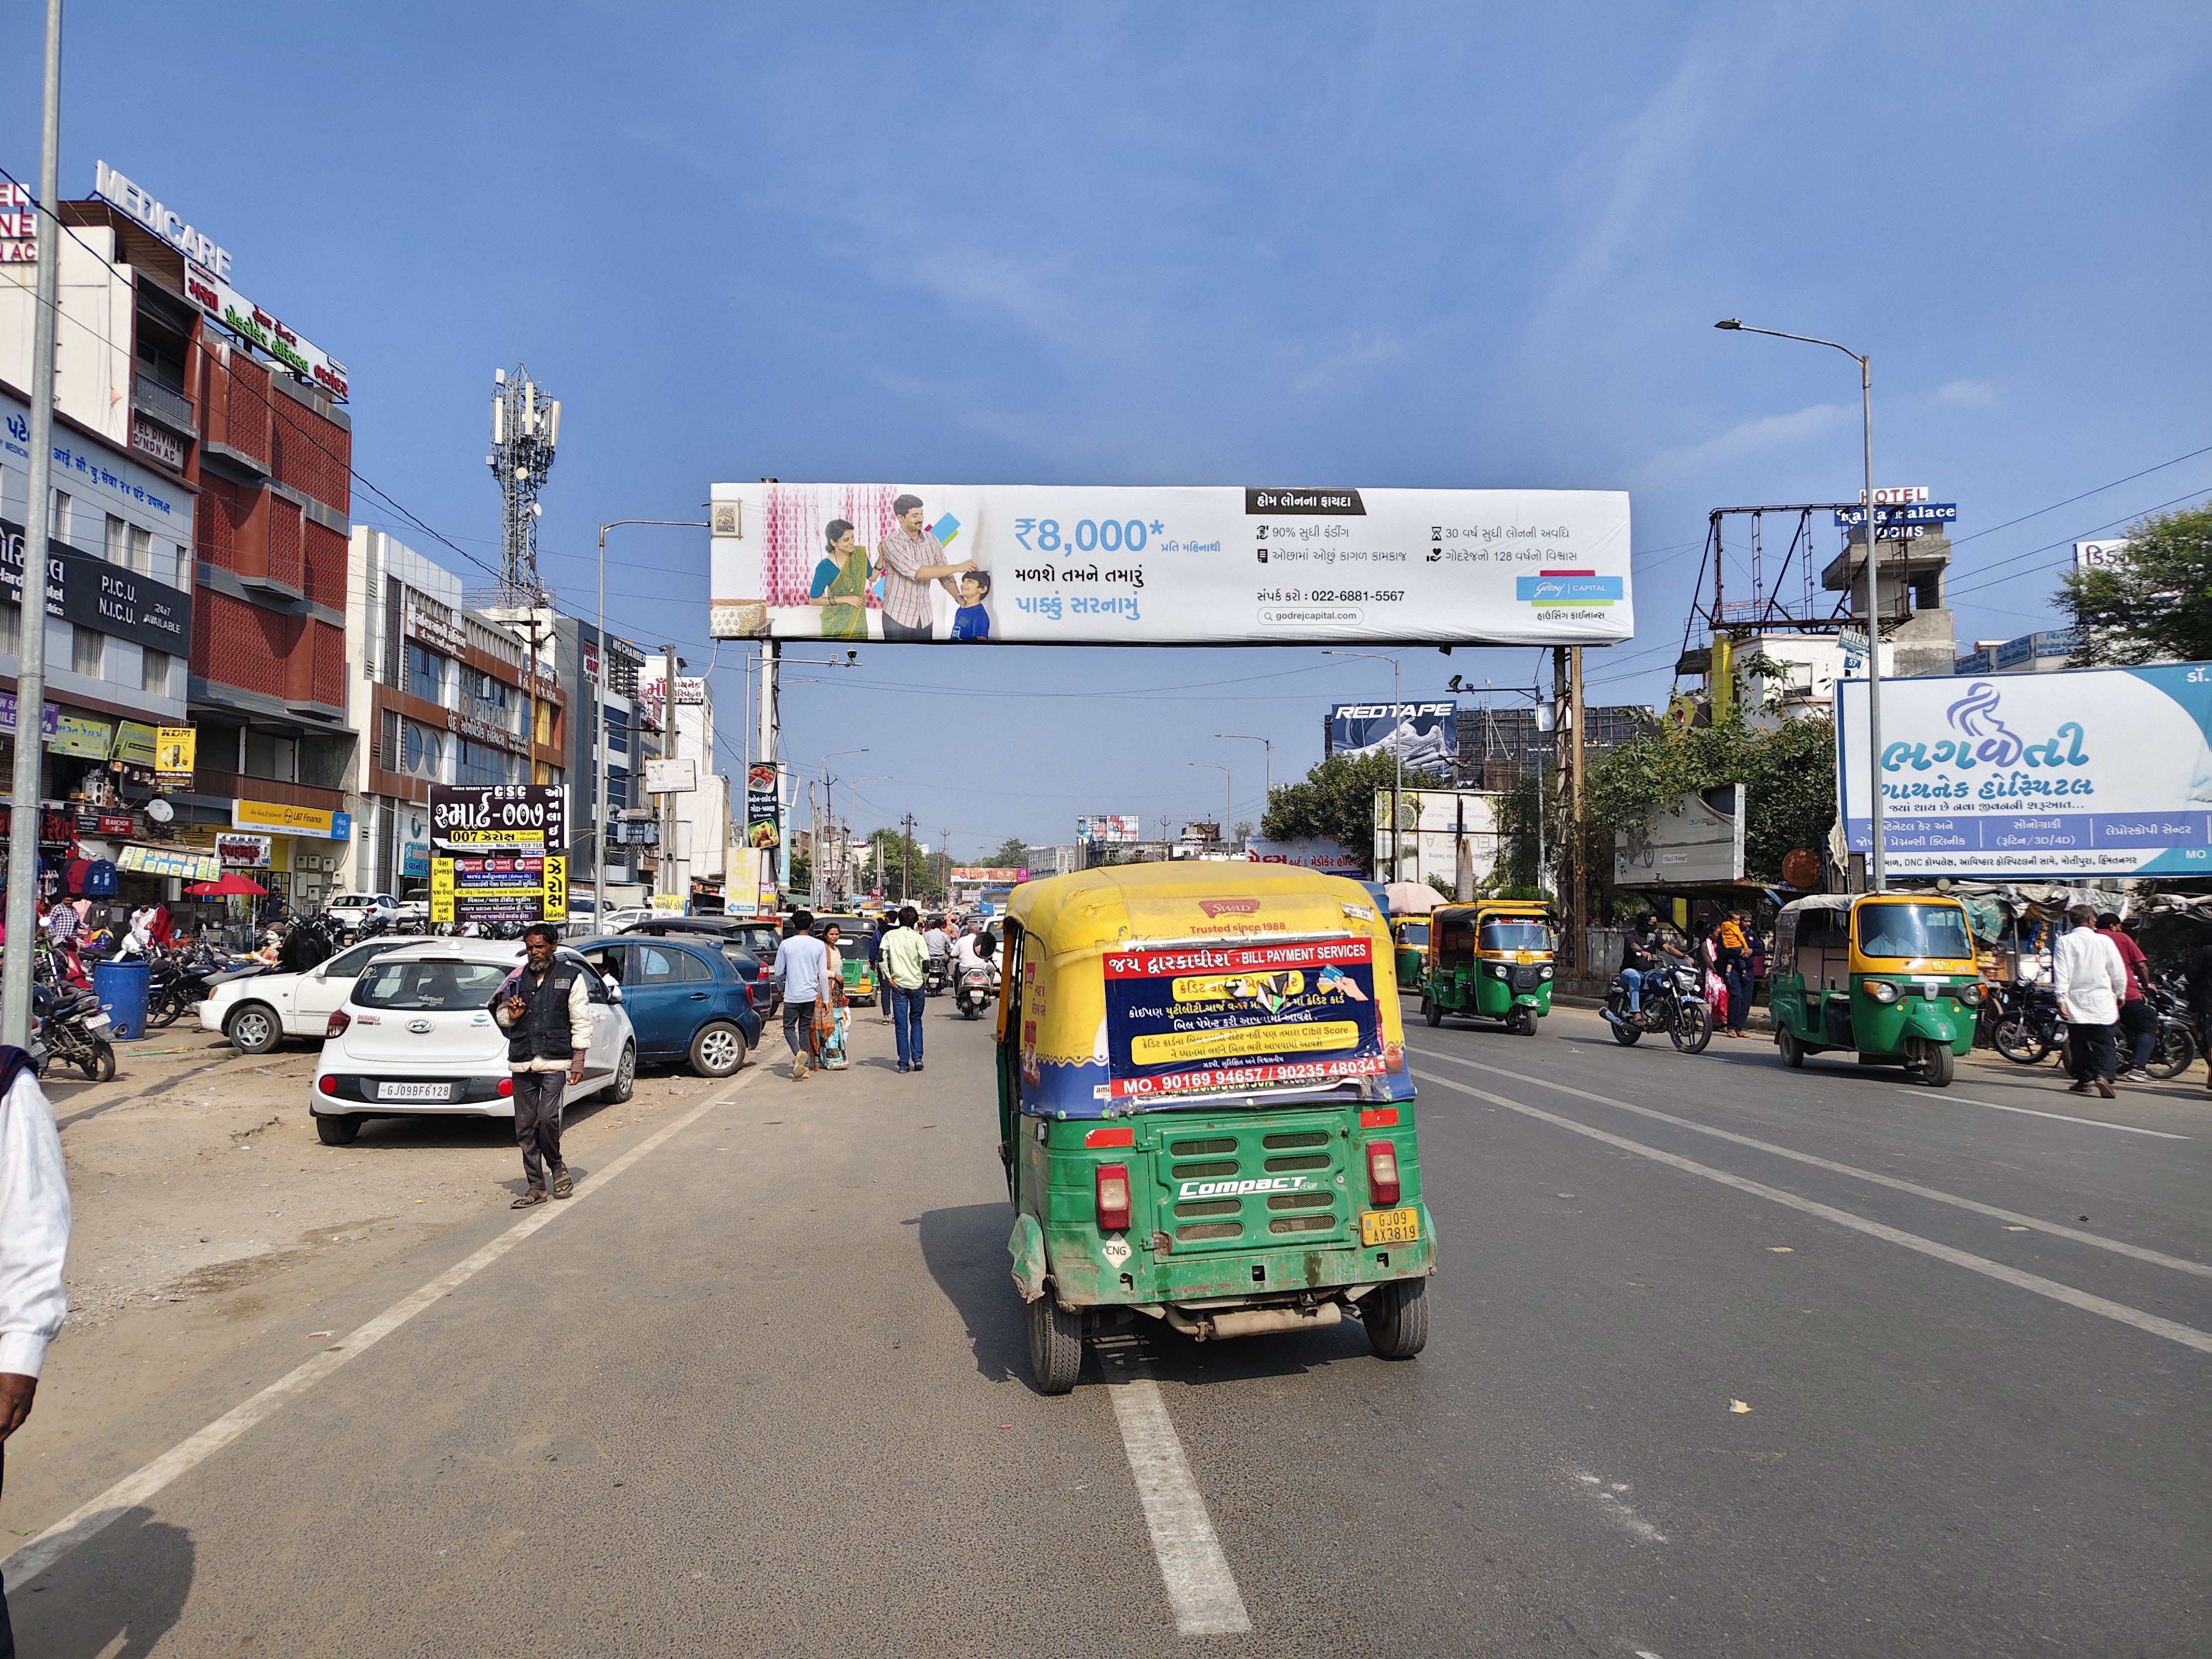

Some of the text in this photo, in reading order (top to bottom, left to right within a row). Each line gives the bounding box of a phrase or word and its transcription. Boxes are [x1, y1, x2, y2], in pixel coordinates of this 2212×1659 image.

[96, 159, 232, 285] MEDICARE
[152, 428, 182, 452] DIVINE
[164, 448, 175, 462] AC
[102, 468, 117, 489] सेवा
[1257, 492, 1351, 508] હોમ લોનના ફાયદા
[1272, 525, 1349, 541] 90% સુધી ફંડીંગ
[1446, 526, 1569, 541] 30 વર્ષ સુધી લોનની અવધિ
[1865, 525, 1924, 538] OOMS
[1161, 541, 1220, 552] પ્રતિ મહિનાથી
[1272, 548, 1407, 564] ઓછામાં ઓછું કાગળ કામકાજ
[1445, 549, 1577, 561] ગોદરેજનો 128 વર્ષનો વિશ્વાસ
[1015, 563, 1144, 588] મળશે તમને તમારું
[101, 575, 137, 604] P.I.C.U.
[1257, 589, 1405, 602] સંપર્ક કરો 022-6881-5567
[98, 596, 136, 625] N.I.C.U.
[1070, 590, 1141, 621] સરનામું
[1276, 611, 1357, 622] godrejcapital.com
[1537, 610, 1568, 621] હાઉસિંગ
[143, 612, 181, 635] AVAILABLE
[612, 639, 622, 651] MG
[1849, 658, 1857, 667] 57
[1335, 703, 1454, 720] REDTAPE
[161, 729, 191, 737] KDM
[1881, 721, 2089, 772] ભગવતી
[1978, 770, 2094, 800] હોસ્પિટલ
[1914, 800, 2023, 812] થાય છે નવા જીવનની
[293, 812, 322, 824] L&T Finance
[1917, 819, 1953, 831] કેર અને
[2013, 818, 2061, 830] સોનોગ્રાફી
[453, 830, 515, 842] 007 ઝેરોક્ષ
[2161, 825, 2191, 834] સેન્ટર
[1905, 858, 1923, 866] DNC
[1996, 855, 2036, 866] હોસ્પિટલની
[2186, 849, 2206, 859] MO
[1212, 903, 1251, 913] SWAD
[1189, 922, 1286, 934] Trusted since 1988
[1108, 944, 1366, 974] જય દ્વારકાધીશ BILL PAYMENT SERVICES
[1179, 979, 1206, 994] ક્રેડિટ
[1129, 1006, 1163, 1019] કોઈપણ
[1306, 995, 1327, 1006] ક્રેડિટ
[1330, 992, 1345, 1004] કાર્ડ
[1174, 1019, 1195, 1031] બિલ
[1195, 1017, 1219, 1029] પેમેન્ટ
[1223, 1015, 1237, 1027] કરી
[1142, 1038, 1161, 1049] ક્રેડિટ
[1163, 1036, 1184, 1047] કાર્ડના
[1279, 1029, 1300, 1037] તમારા
[1301, 1027, 1321, 1035] Cibil
[1324, 1027, 1348, 1035] Score
[1229, 1043, 1245, 1053] બિલ
[1247, 1041, 1262, 1051] ભરી
[1264, 1039, 1298, 1050] આપવામાં
[1299, 1037, 1323, 1047] આવશે
[1245, 1056, 1256, 1064] અને
[1123, 1078, 1157, 1095] MO.
[1162, 1071, 1211, 1090] 90169
[1215, 1067, 1264, 1085] 94657
[1277, 1064, 1325, 1079] 90235
[1328, 1059, 1377, 1076] 48034
[387, 1085, 449, 1096] GJ09BF6128
[1379, 1211, 1407, 1227] GJ09
[1374, 1225, 1415, 1243] AX3819
[1105, 1245, 1127, 1257] CNG
